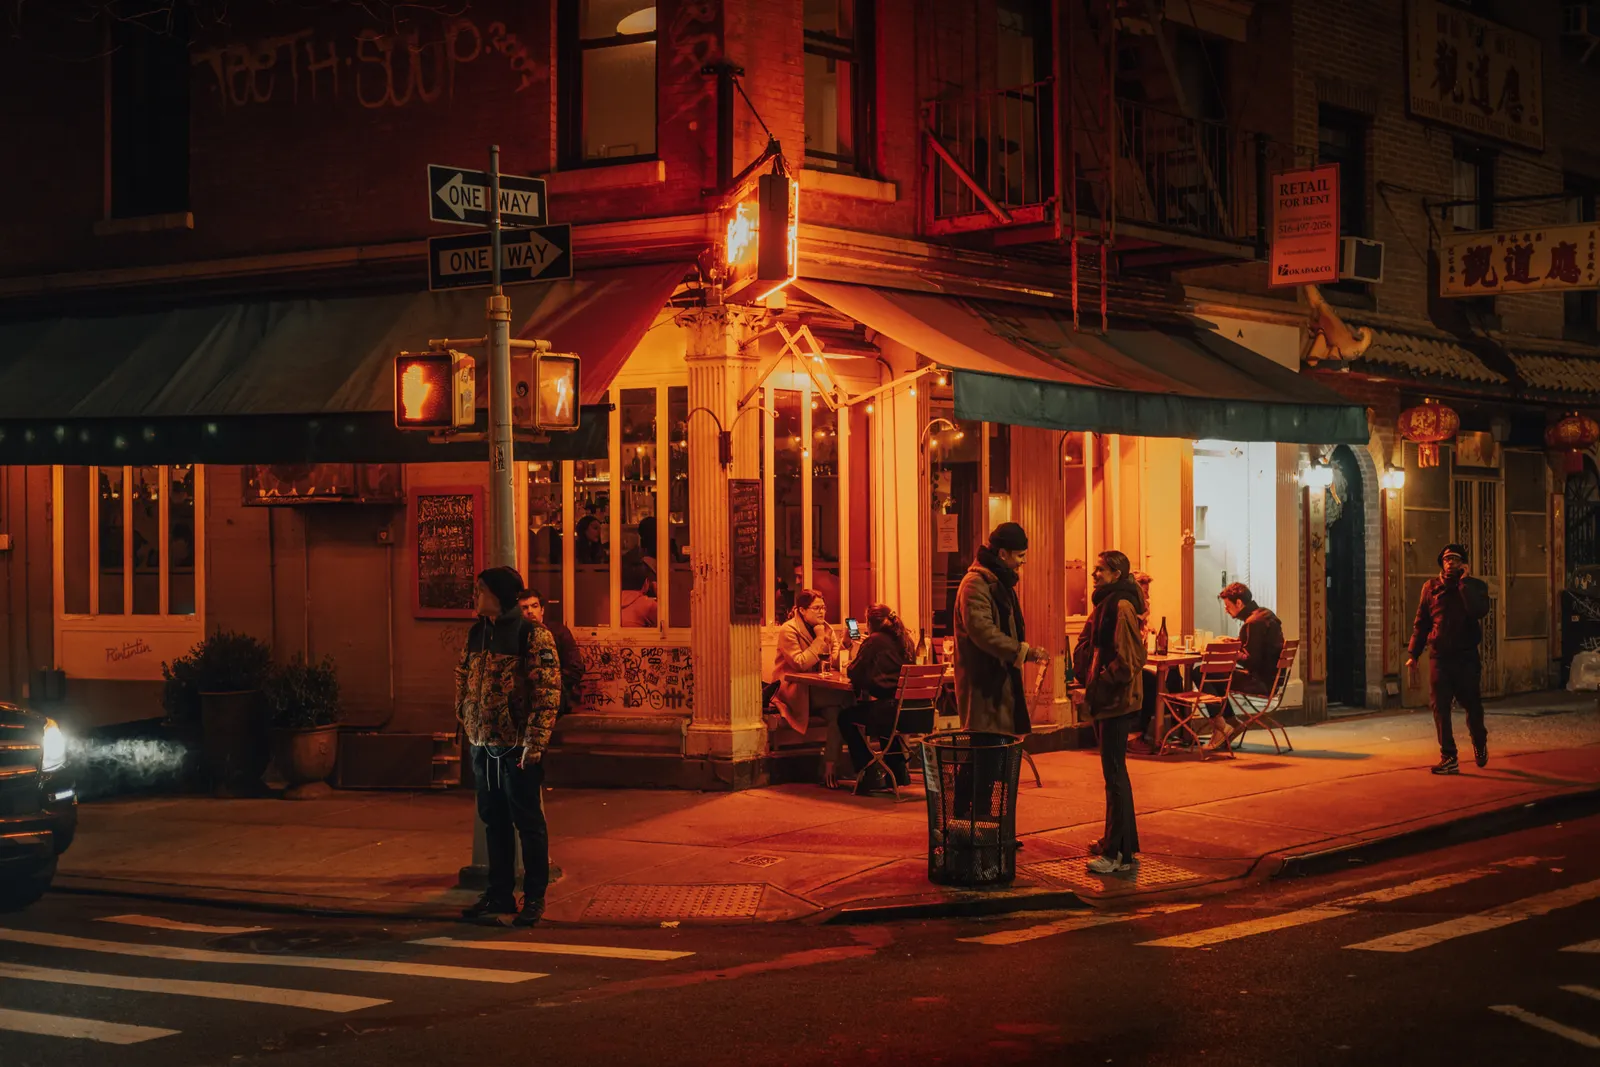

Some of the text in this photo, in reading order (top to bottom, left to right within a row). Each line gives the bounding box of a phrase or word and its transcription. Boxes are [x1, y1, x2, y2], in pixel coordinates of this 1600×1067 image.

[449, 185, 531, 214] ONE WAY
[1279, 179, 1331, 196] RETAIL
[1279, 194, 1330, 209] FOR RENT
[450, 243, 548, 272] ONE WAY
[105, 638, 152, 665] Rintintin
